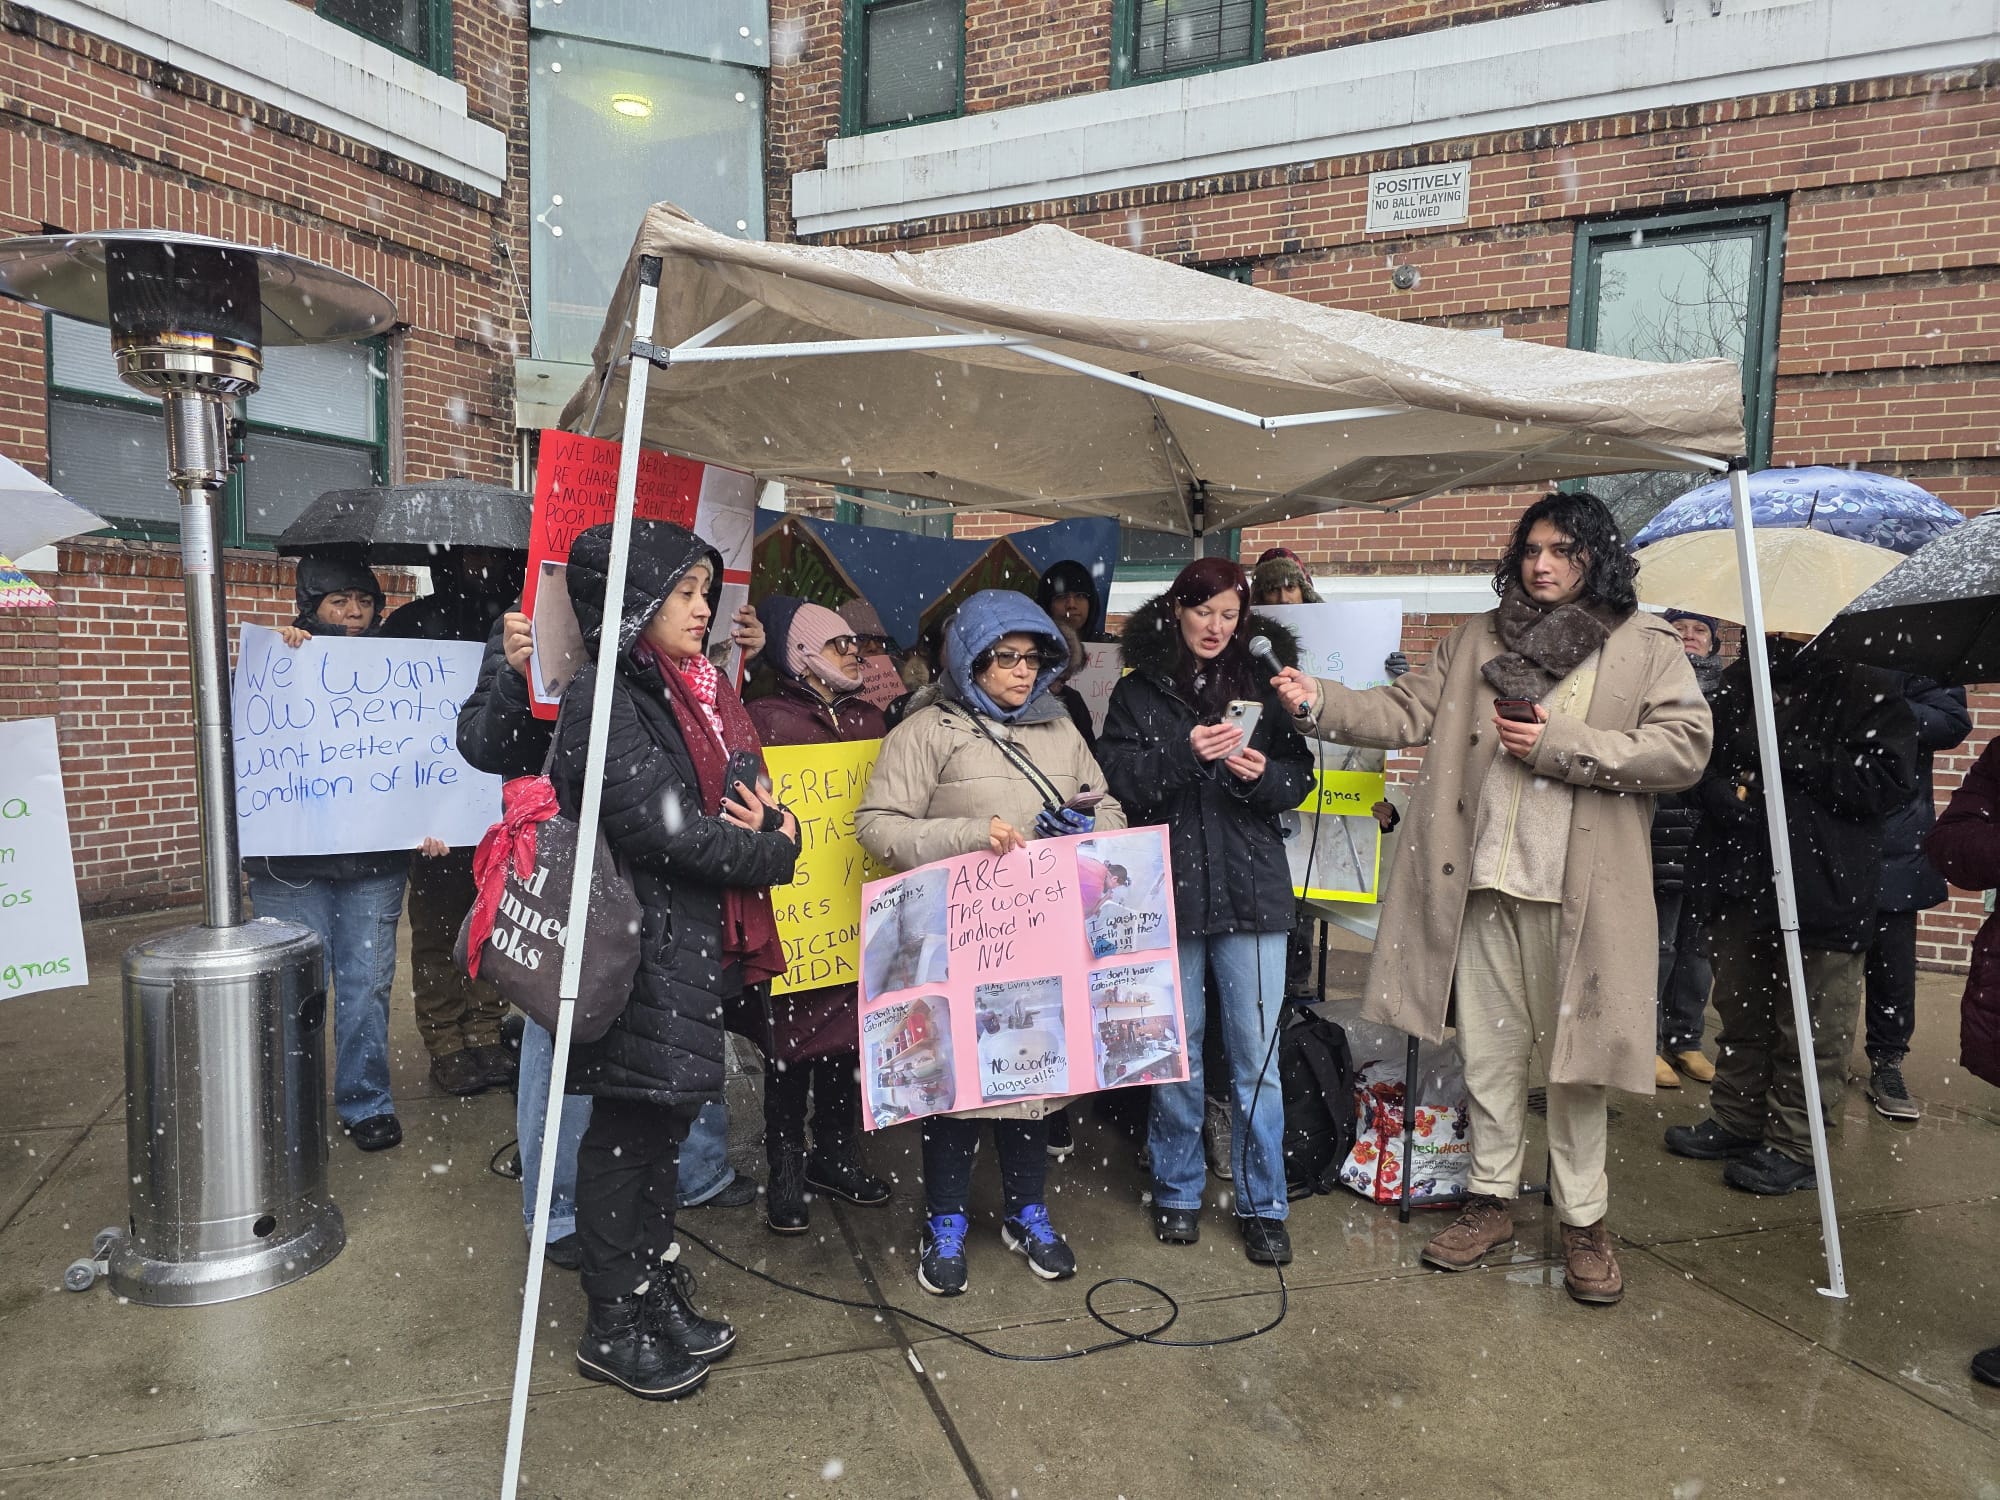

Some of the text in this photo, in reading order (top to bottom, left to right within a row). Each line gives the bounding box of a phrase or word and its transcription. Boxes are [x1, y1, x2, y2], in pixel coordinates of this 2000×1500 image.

[1377, 172, 1462, 194] POSITIVELY
[1375, 191, 1461, 210] NO BALL PLAYING
[1393, 206, 1440, 220] ALLOWED
[556, 439, 584, 461] WE
[554, 465, 571, 485] BE
[578, 467, 618, 490] CHARG
[546, 487, 617, 510] AMOUNT
[545, 503, 585, 526] POOR
[319, 735, 413, 764] better
[370, 765, 402, 792] of
[801, 810, 856, 849] TAS
[951, 852, 1014, 900] A&E
[775, 898, 831, 923] ORES
[947, 879, 1067, 929] The worst
[780, 922, 860, 965] DICION
[950, 909, 1045, 952] Landlord in
[491, 925, 543, 970] oks
